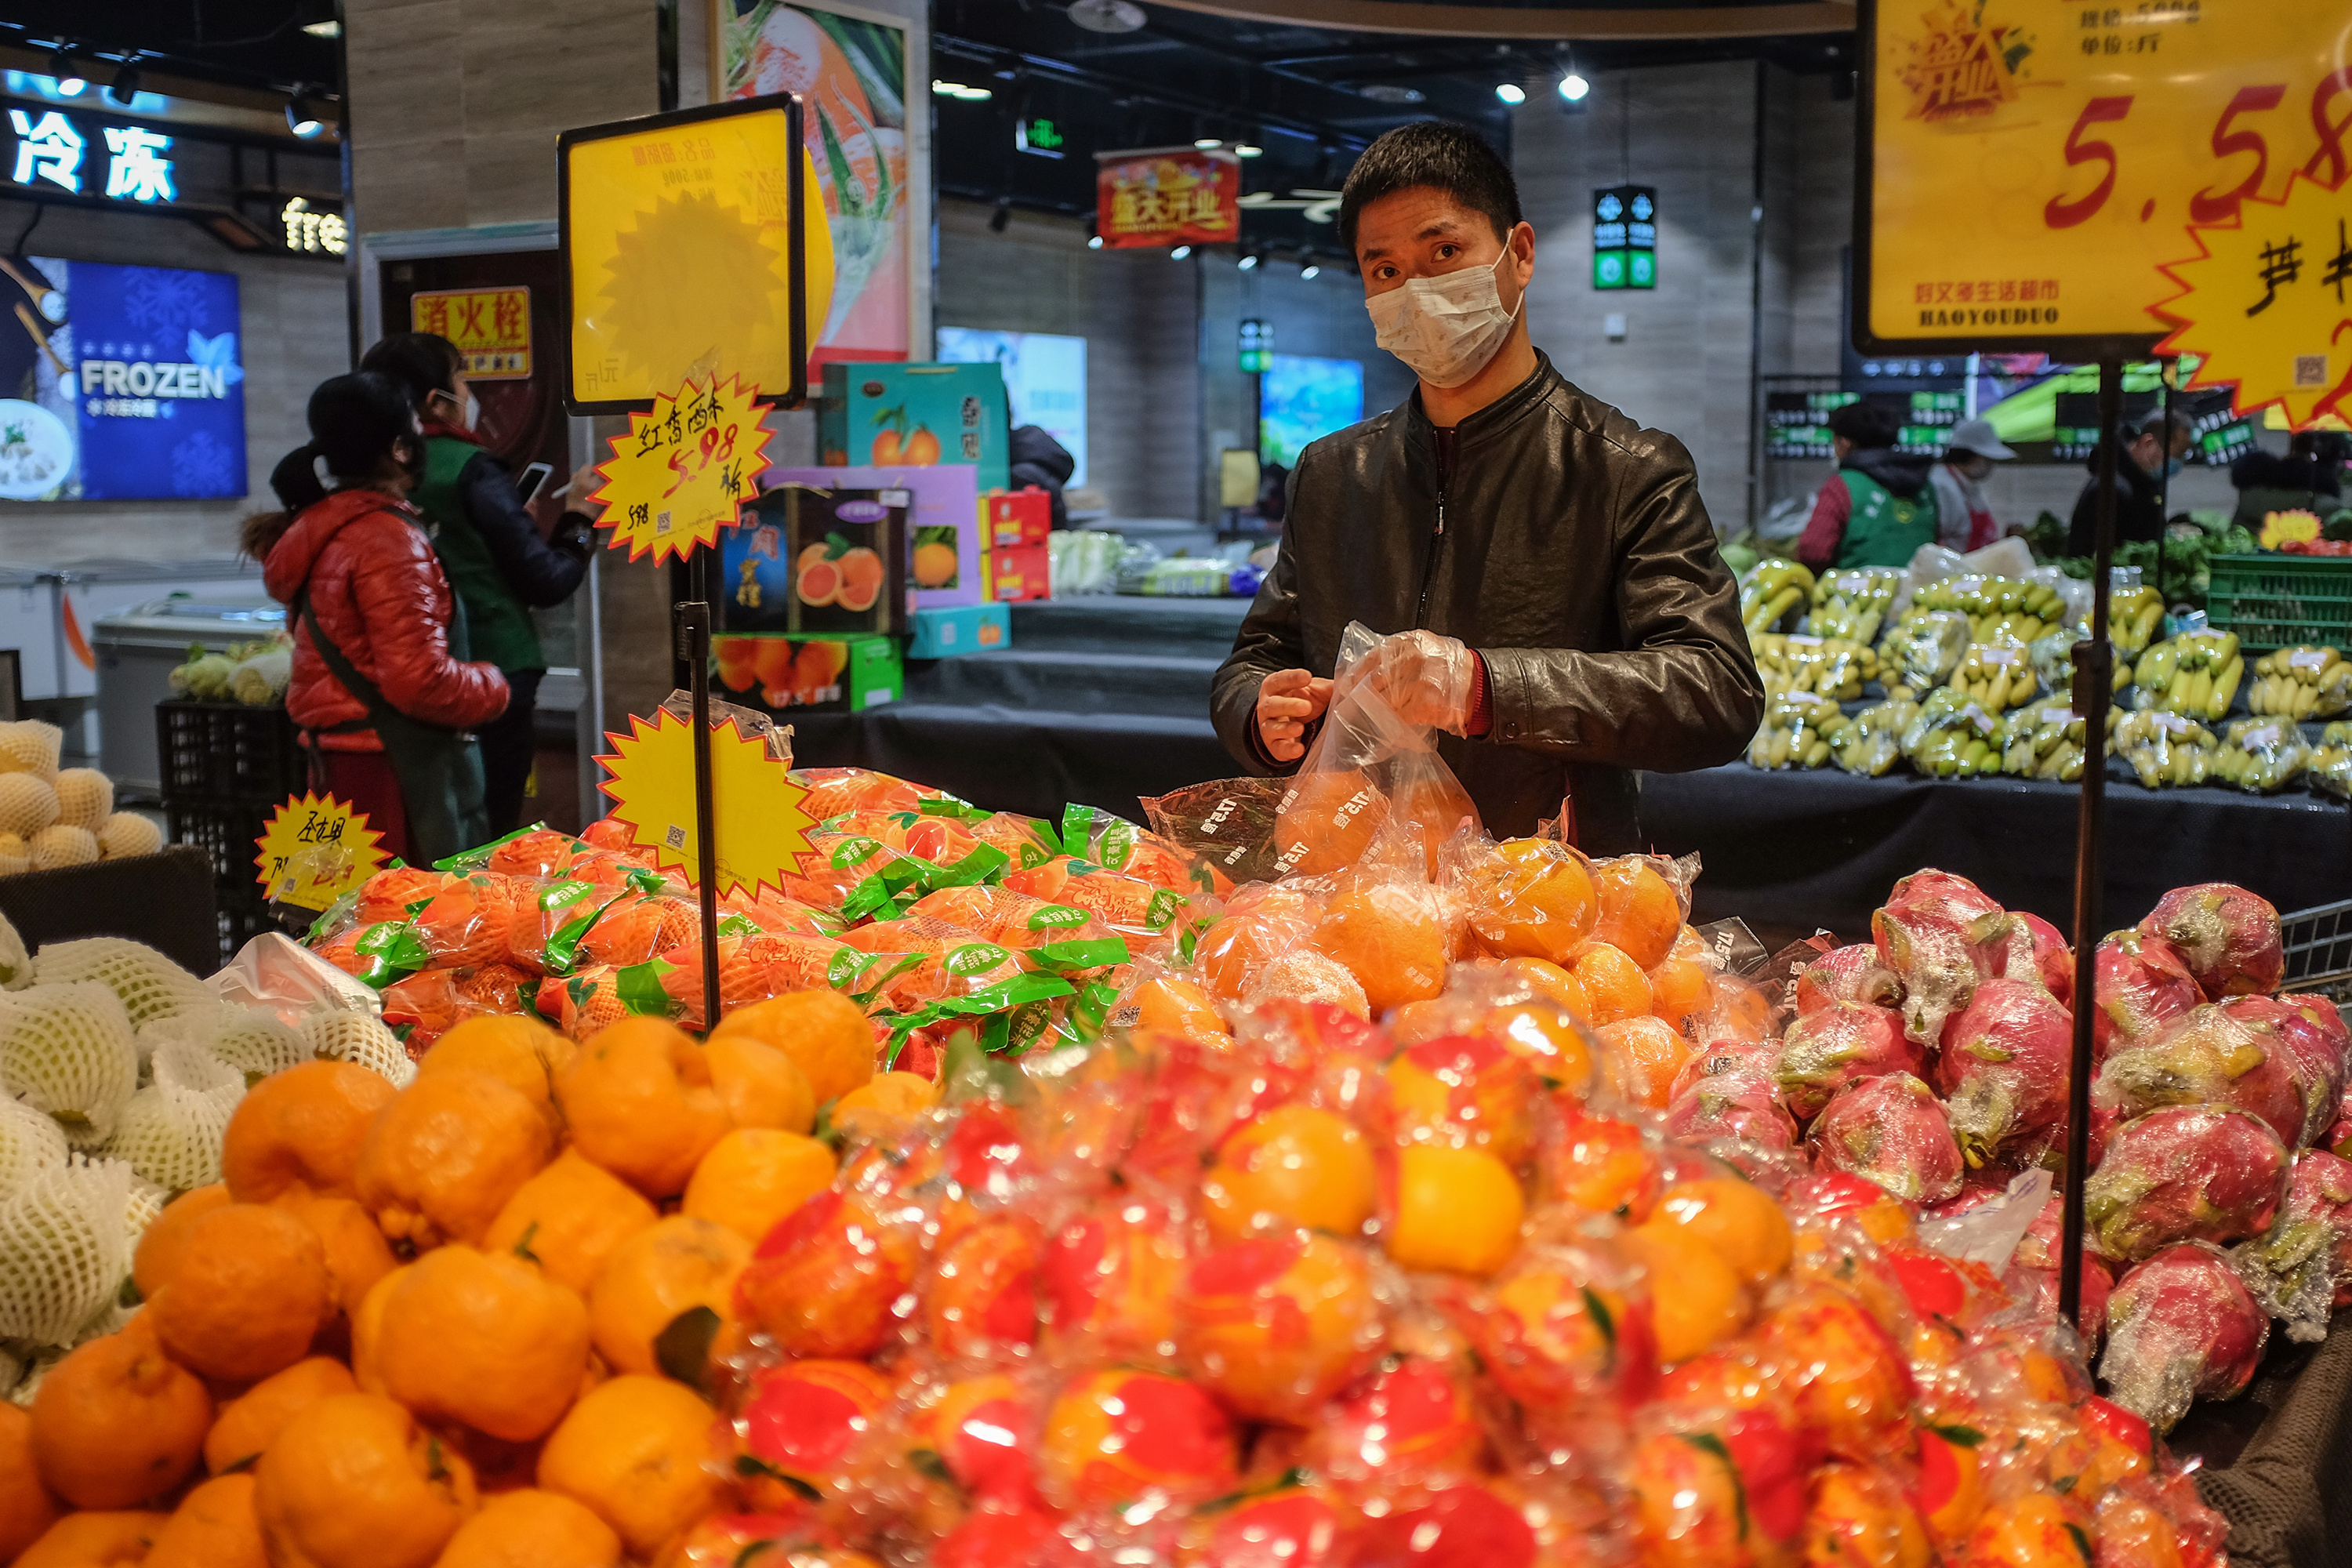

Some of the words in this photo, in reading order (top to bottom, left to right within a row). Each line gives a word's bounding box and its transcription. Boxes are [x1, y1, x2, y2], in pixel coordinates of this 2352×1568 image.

[9, 109, 178, 204] 冷冻
[1915, 279, 2060, 303] 好又多生活超市
[419, 292, 523, 341] 消火栓
[1918, 308, 2060, 328] HAOYOUDUO
[80, 359, 227, 399] FROZEN
[636, 386, 724, 458] 红香酥
[662, 423, 739, 499] 5.98
[1711, 931, 1735, 971] 17.5°橙
[1009, 1002, 1048, 1048] 文豪鲜果
